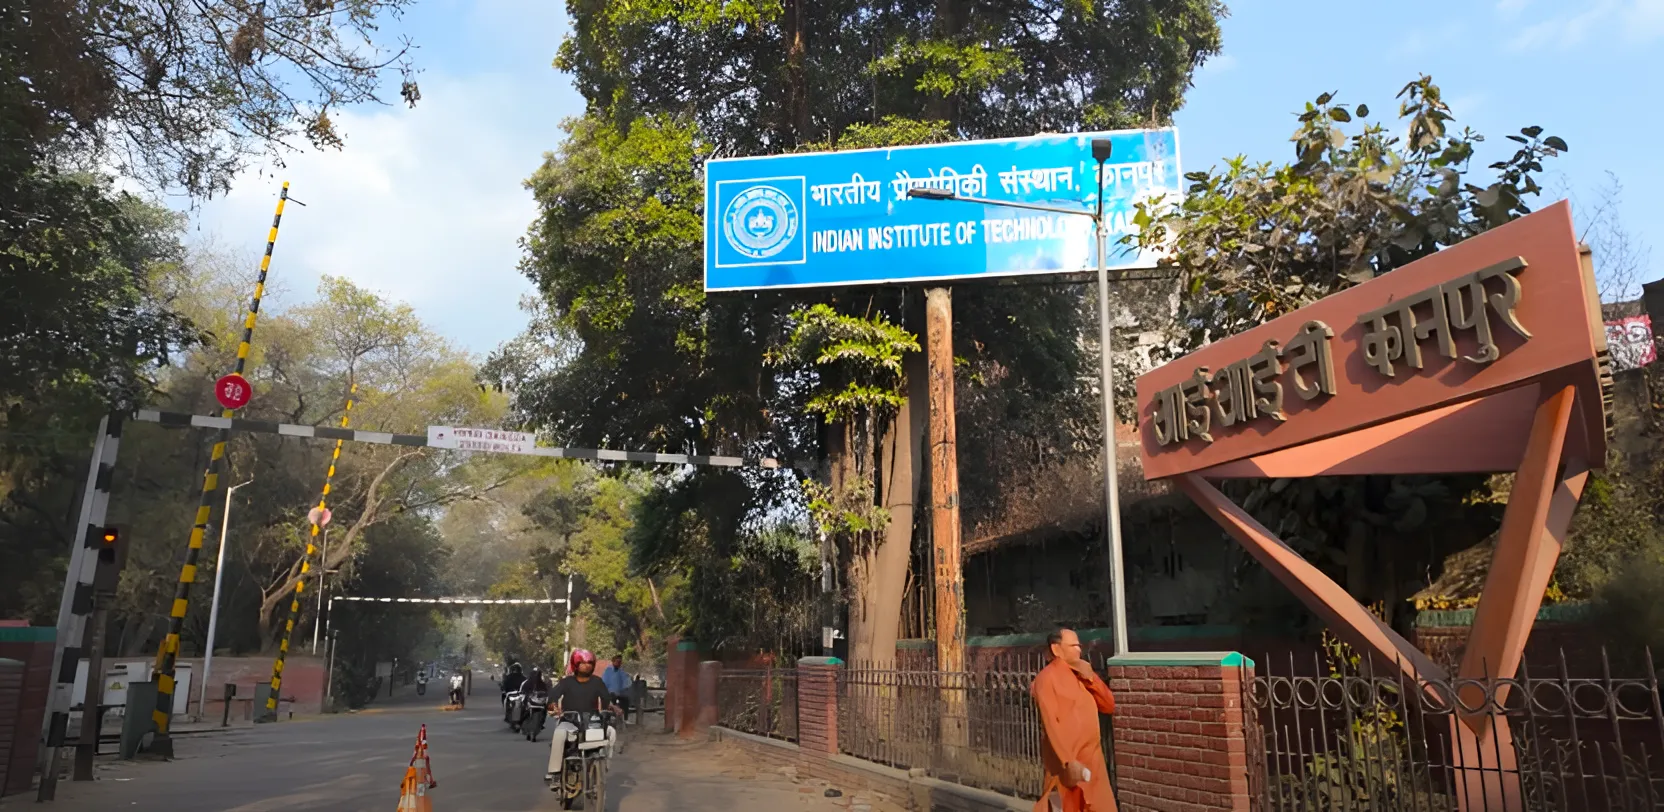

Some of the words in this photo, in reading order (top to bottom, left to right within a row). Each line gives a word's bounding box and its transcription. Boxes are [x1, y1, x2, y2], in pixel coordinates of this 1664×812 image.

[811, 173, 881, 206] भारतीय
[812, 228, 863, 253] INDIAN
[868, 222, 951, 250] INSTITUTE
[955, 221, 976, 245] OF
[1357, 255, 1532, 377] कानपुर
